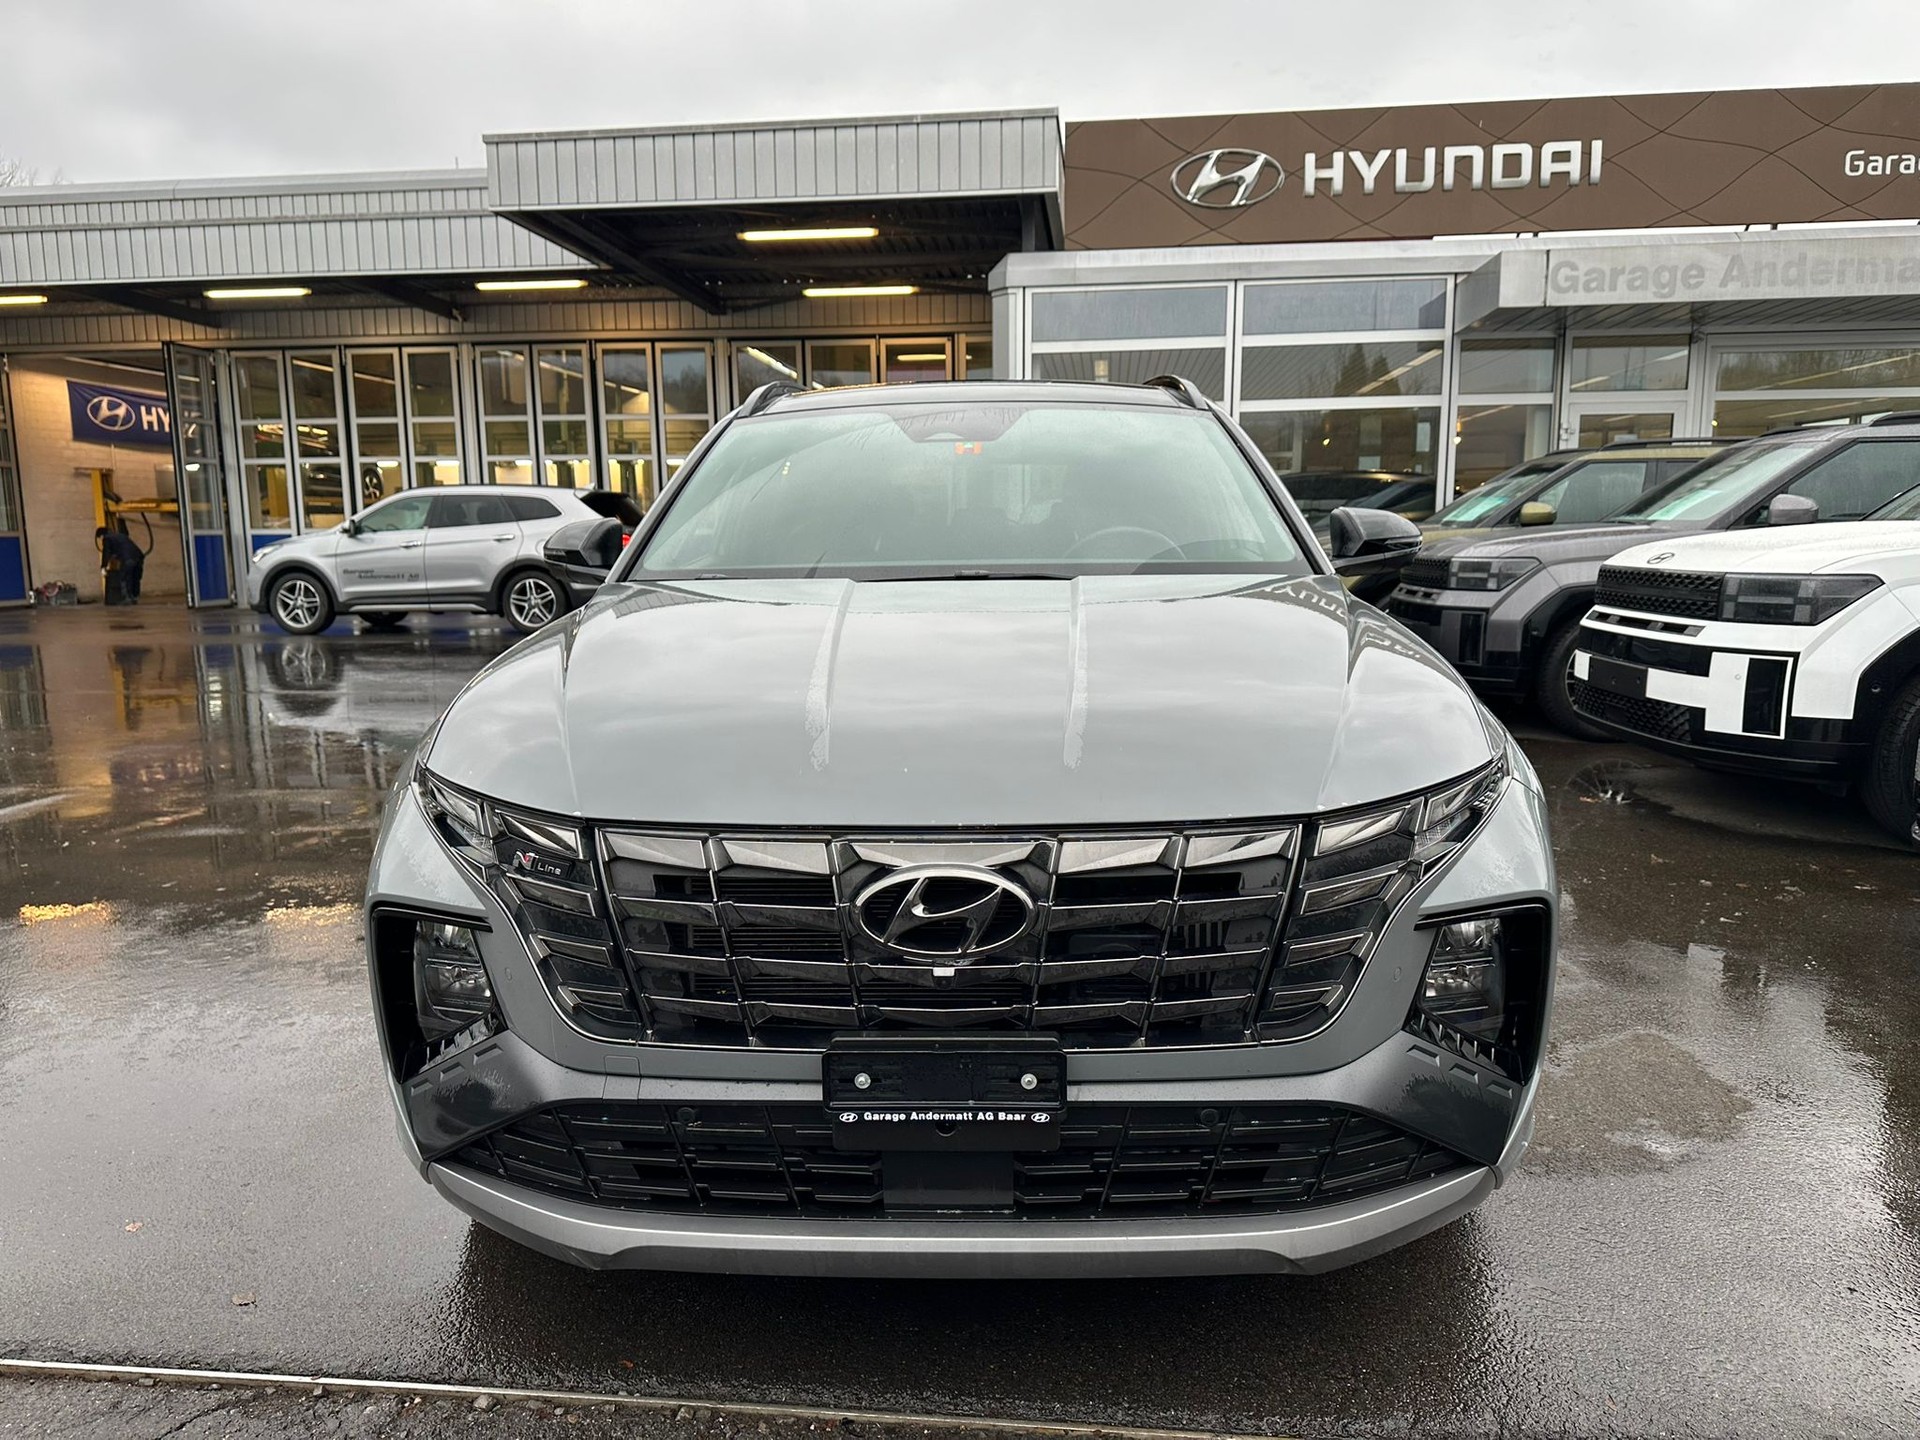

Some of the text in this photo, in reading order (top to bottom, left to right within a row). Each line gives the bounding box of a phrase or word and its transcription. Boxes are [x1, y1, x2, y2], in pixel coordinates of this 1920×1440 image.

[1303, 139, 1603, 197] HYUNDAI
[1844, 149, 1920, 177] Gara
[1550, 251, 1920, 299] Garage Anderma
[537, 862, 562, 875] Line
[863, 1111, 1026, 1122] Garage Andermatt AG Baar
